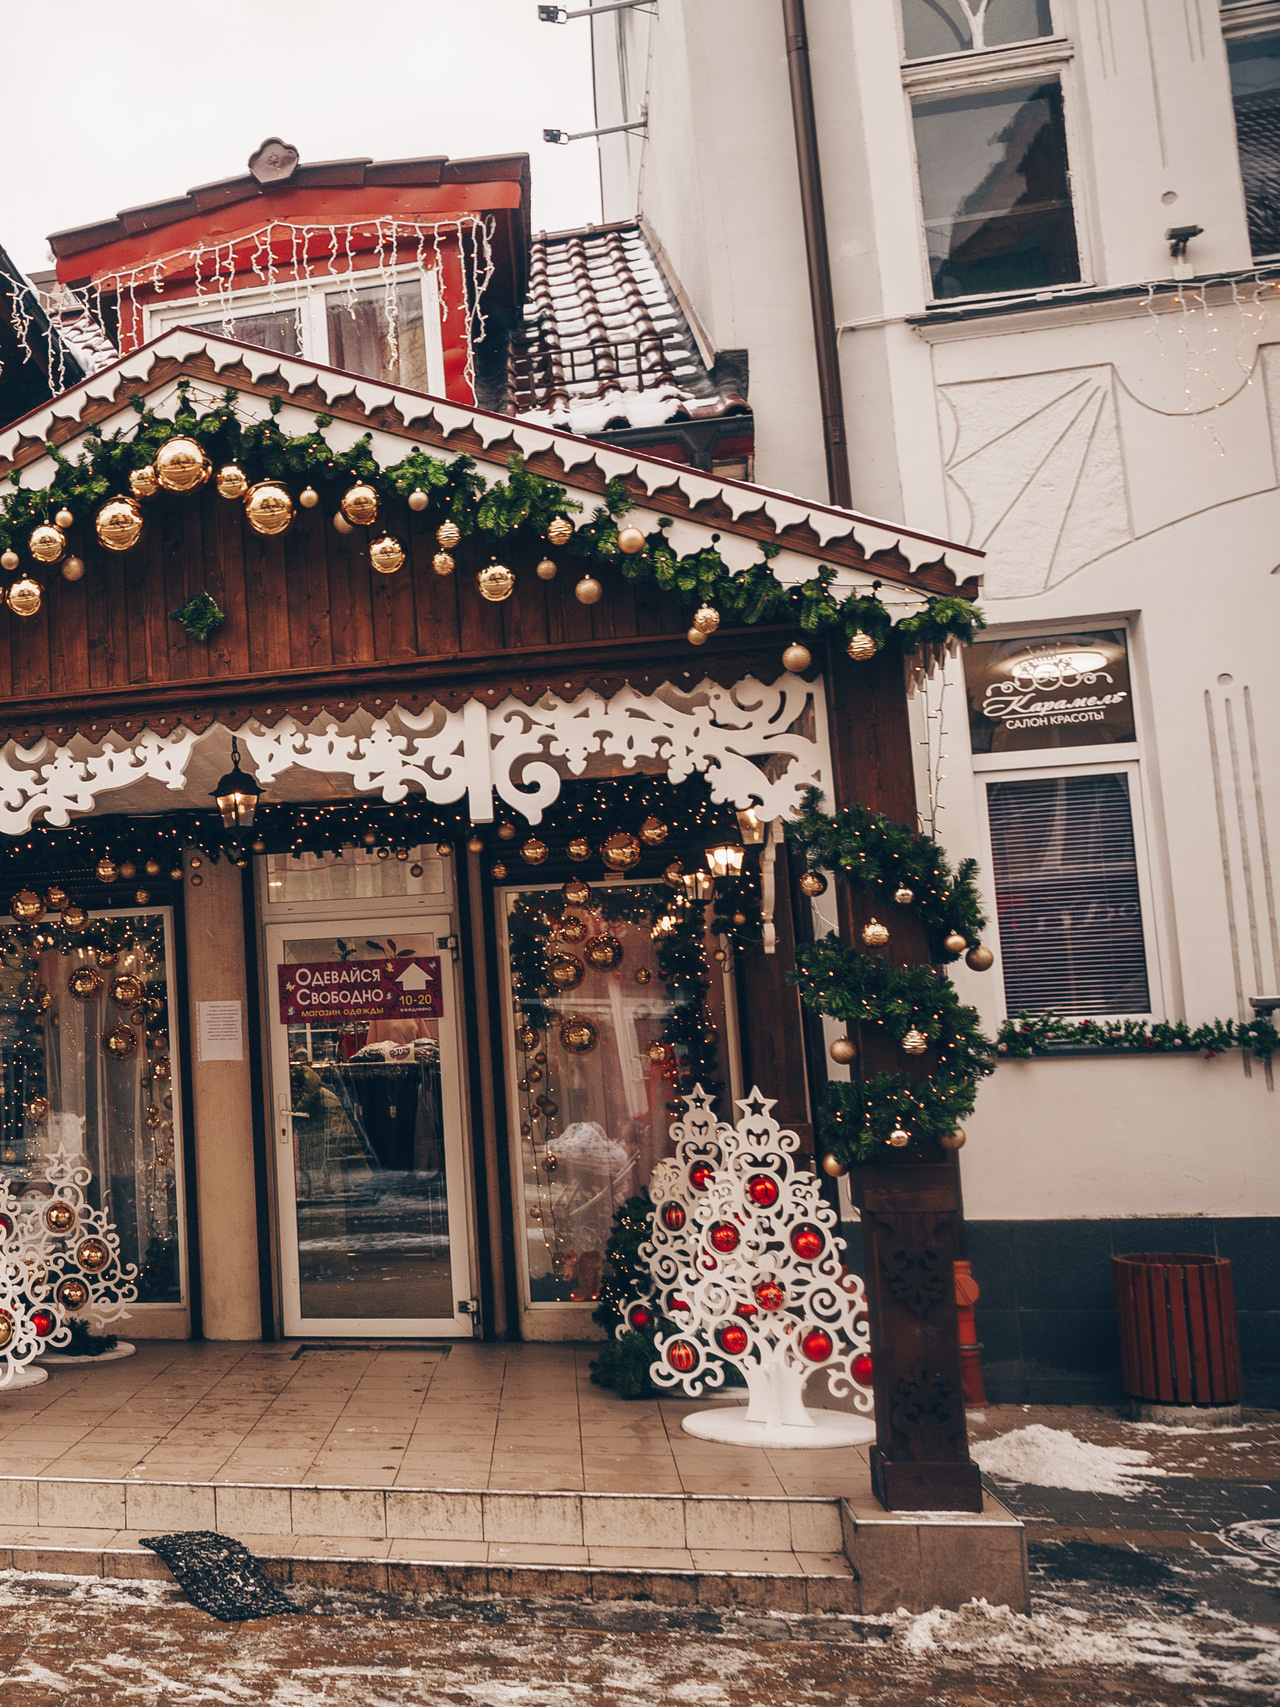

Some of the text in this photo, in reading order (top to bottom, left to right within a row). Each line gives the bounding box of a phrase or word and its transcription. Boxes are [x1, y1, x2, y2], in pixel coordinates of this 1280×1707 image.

[982, 693, 1125, 717] Карамель
[1005, 711, 1105, 730] САЛОН КРАСОТЫ
[399, 994, 432, 1006] 10-20
[301, 1007, 384, 1018] магазин одежды
